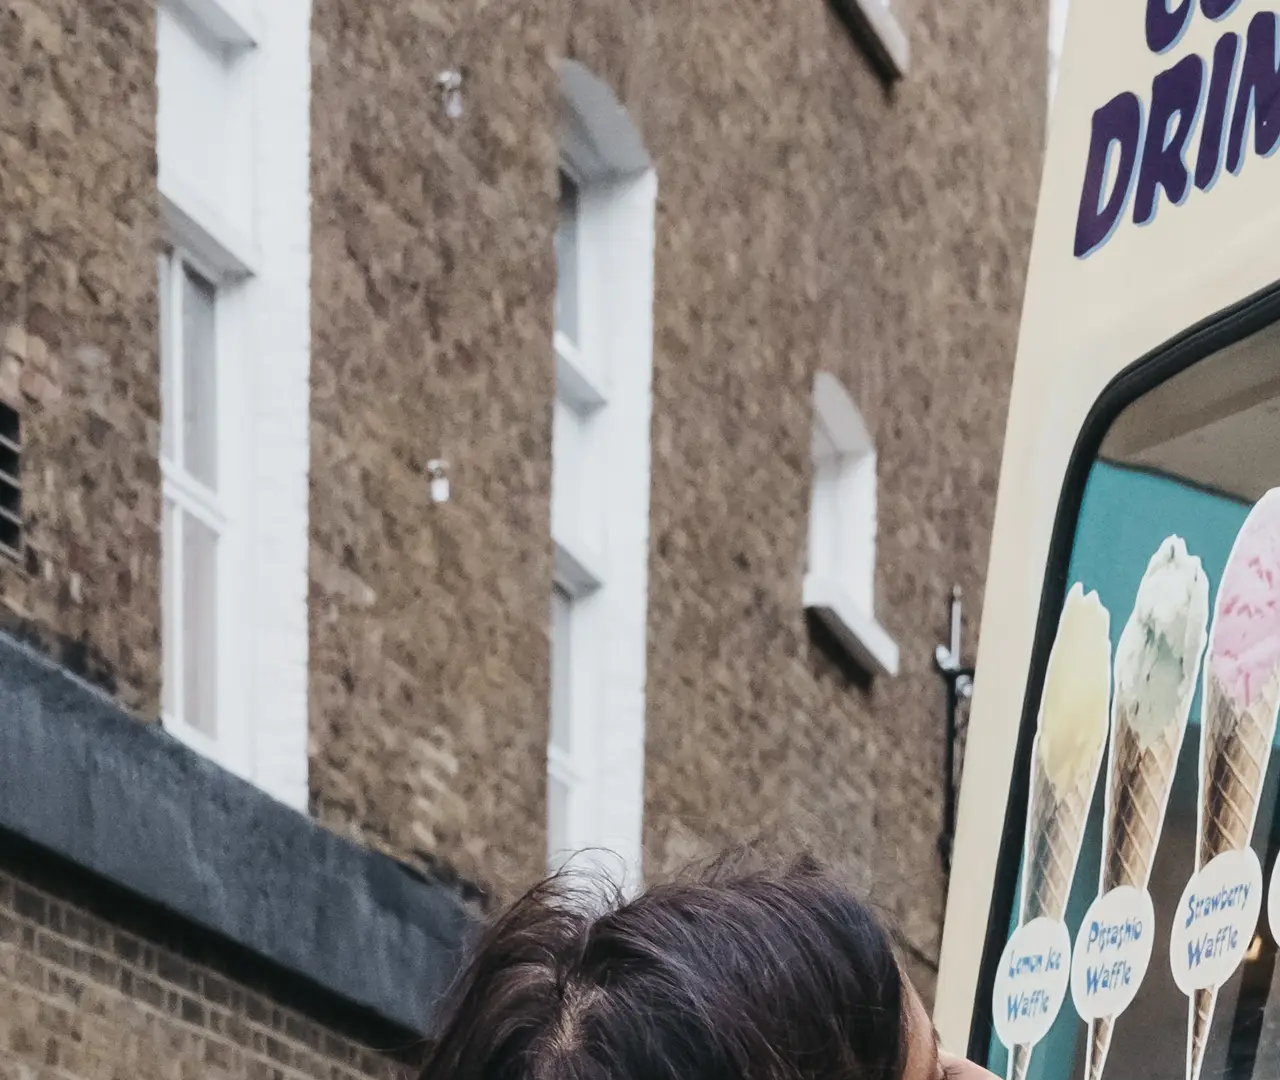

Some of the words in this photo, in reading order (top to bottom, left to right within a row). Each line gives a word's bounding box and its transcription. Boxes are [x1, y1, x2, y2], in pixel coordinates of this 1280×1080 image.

[1185, 880, 1252, 931] Strawberry
[1008, 949, 1043, 979] Lemon
[1045, 946, 1062, 972] Ice
[1187, 930, 1238, 971] Waffle
[1086, 959, 1131, 997] Waffle
[1007, 988, 1049, 1023] Waffle
